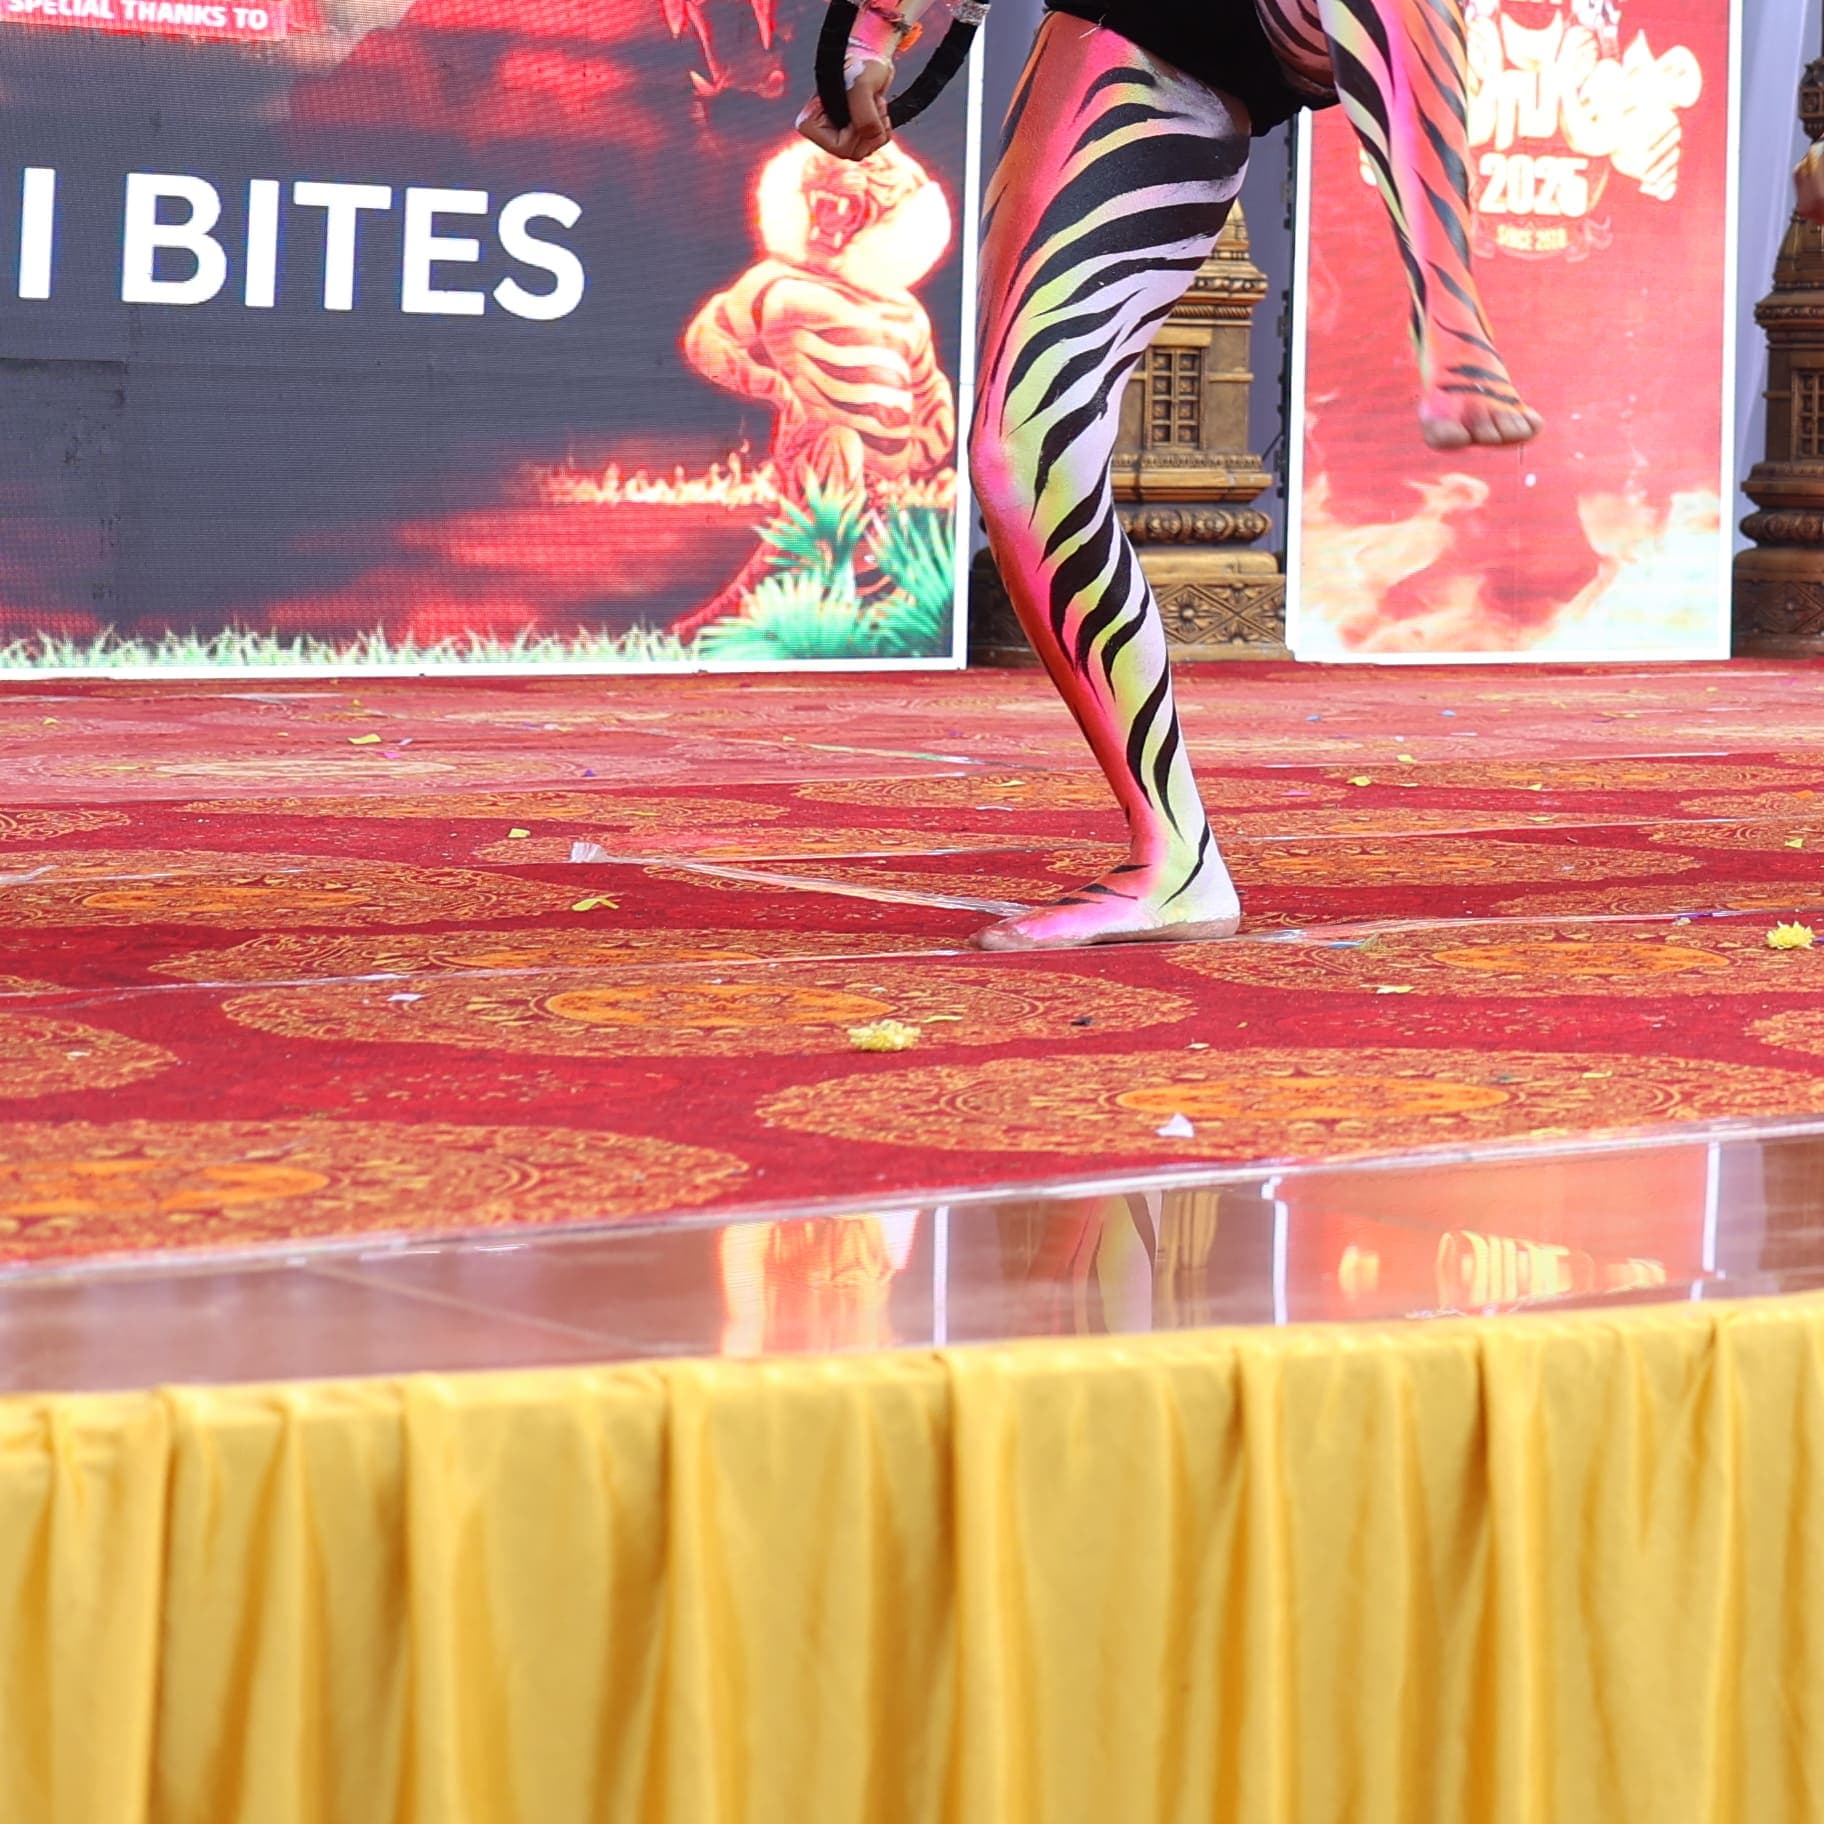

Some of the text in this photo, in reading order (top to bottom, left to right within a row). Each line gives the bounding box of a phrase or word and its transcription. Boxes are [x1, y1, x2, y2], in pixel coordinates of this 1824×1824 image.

[121, 0, 227, 28] THANKS
[232, 7, 269, 31] TO
[121, 172, 585, 321] BITES
